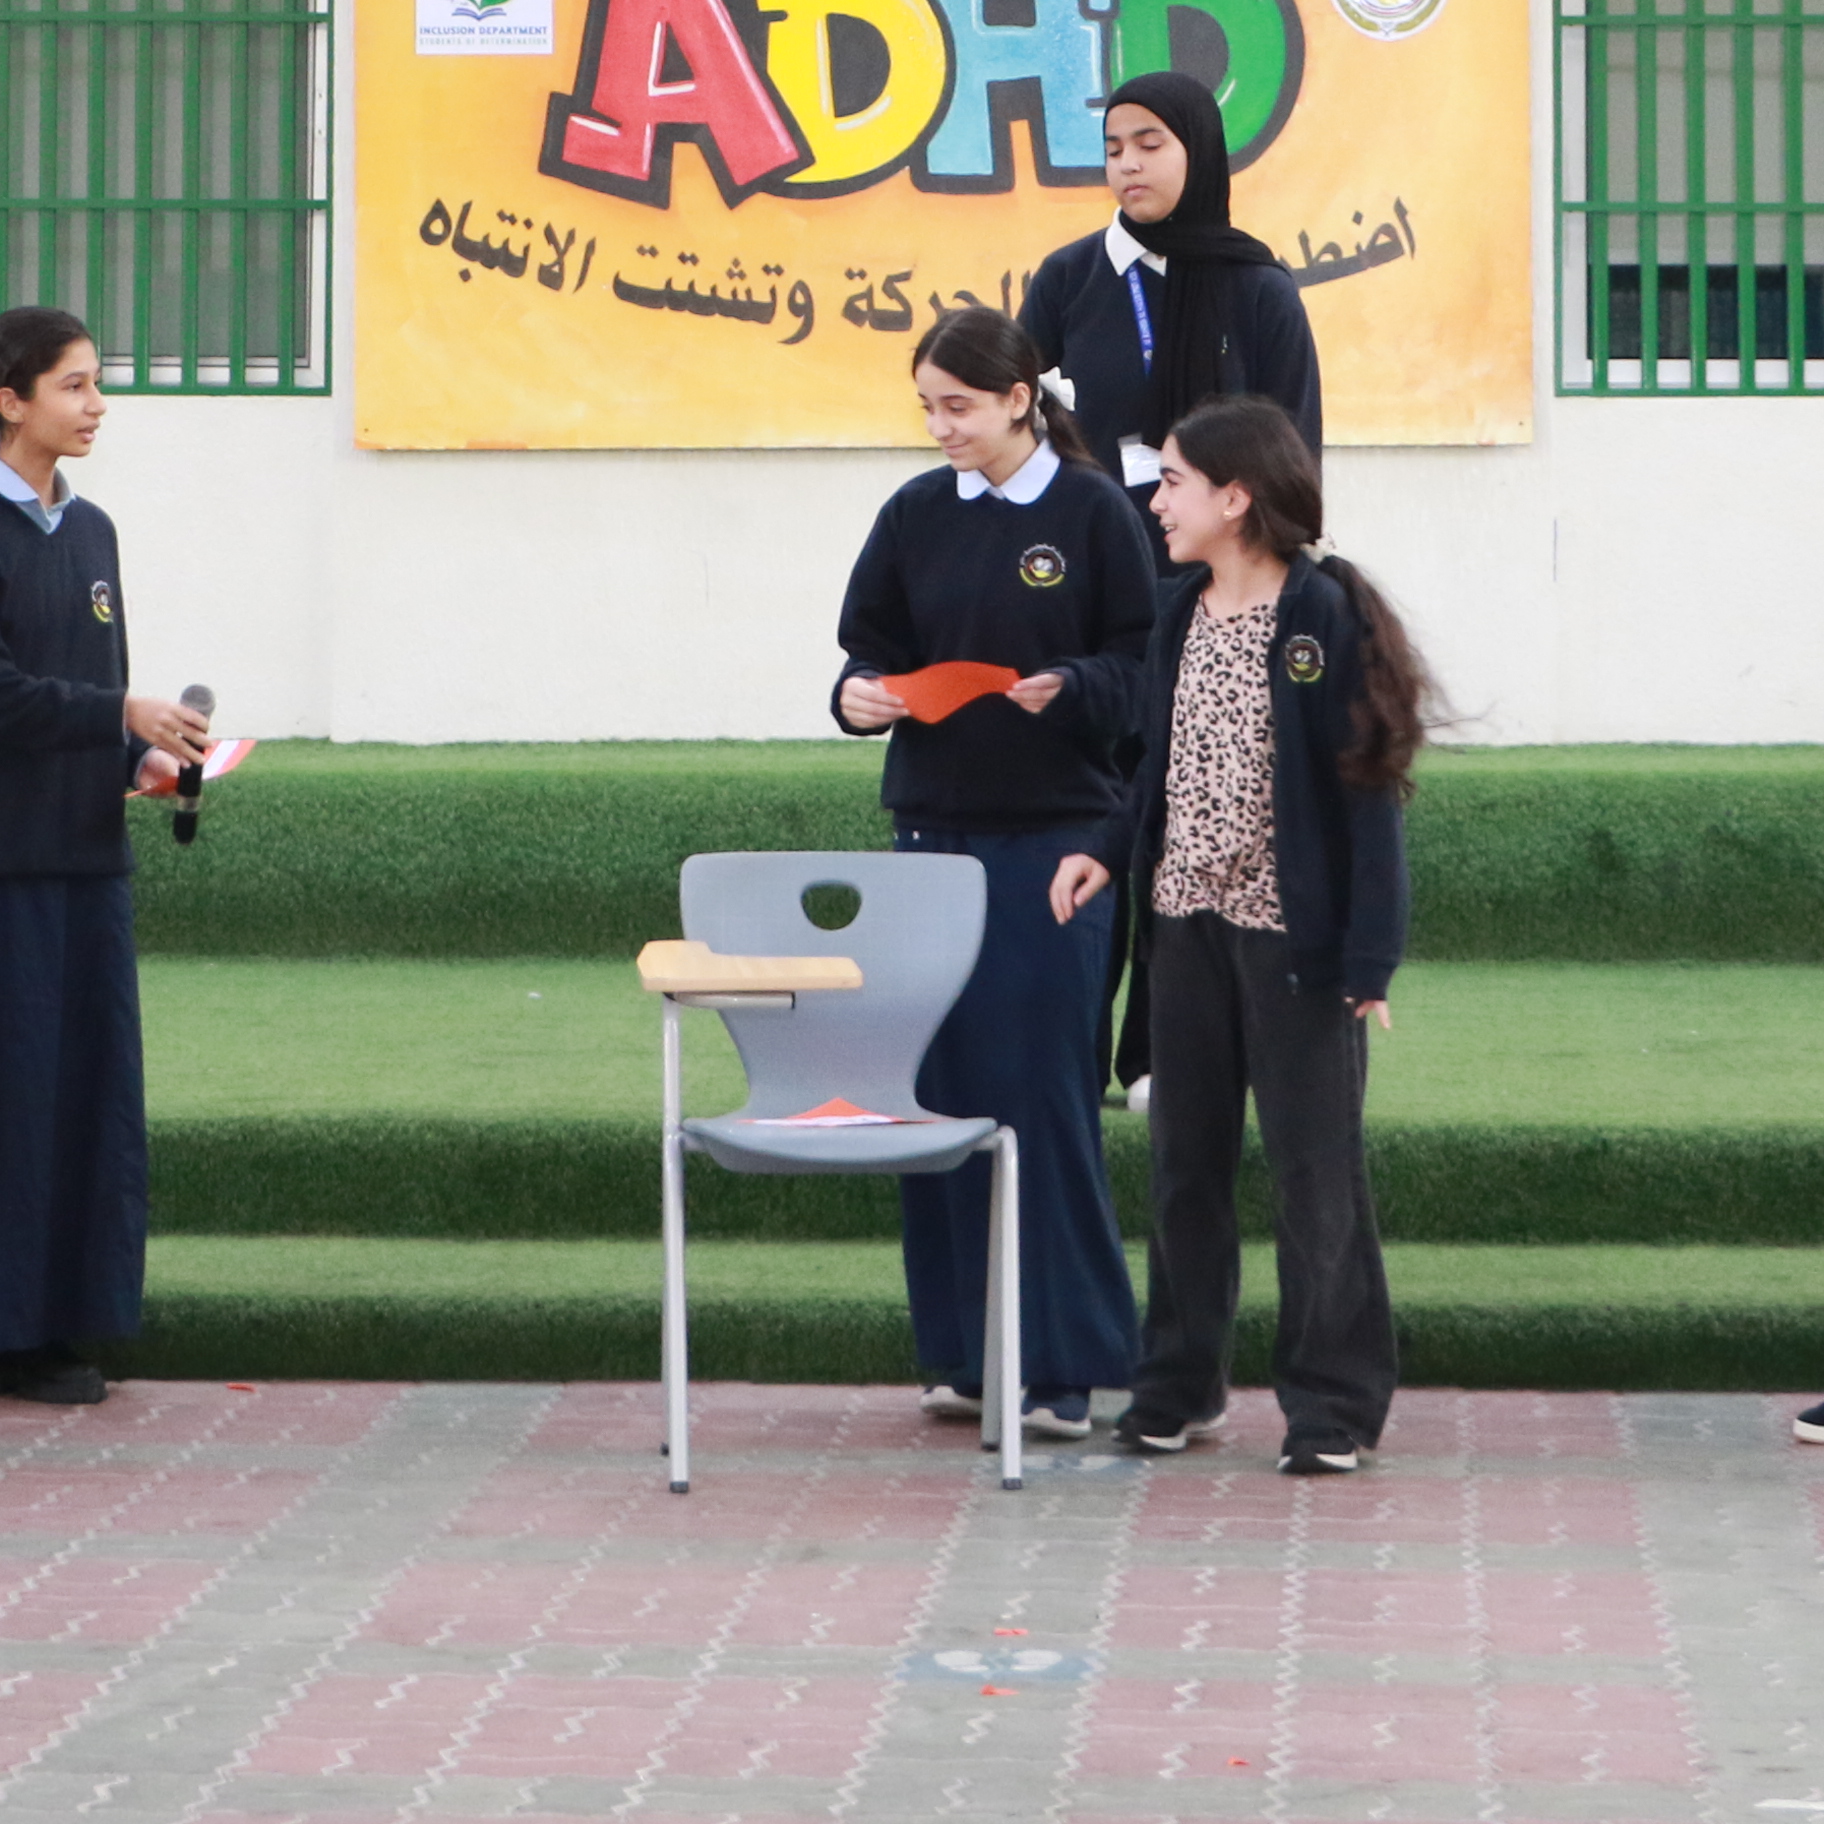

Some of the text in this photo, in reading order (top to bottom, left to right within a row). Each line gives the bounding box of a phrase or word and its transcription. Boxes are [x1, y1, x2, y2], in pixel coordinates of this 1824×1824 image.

[419, 26, 548, 35] INCLUSION DEPARTMENT
[419, 197, 597, 294] الانتباه
[612, 245, 815, 345] وتشتت
